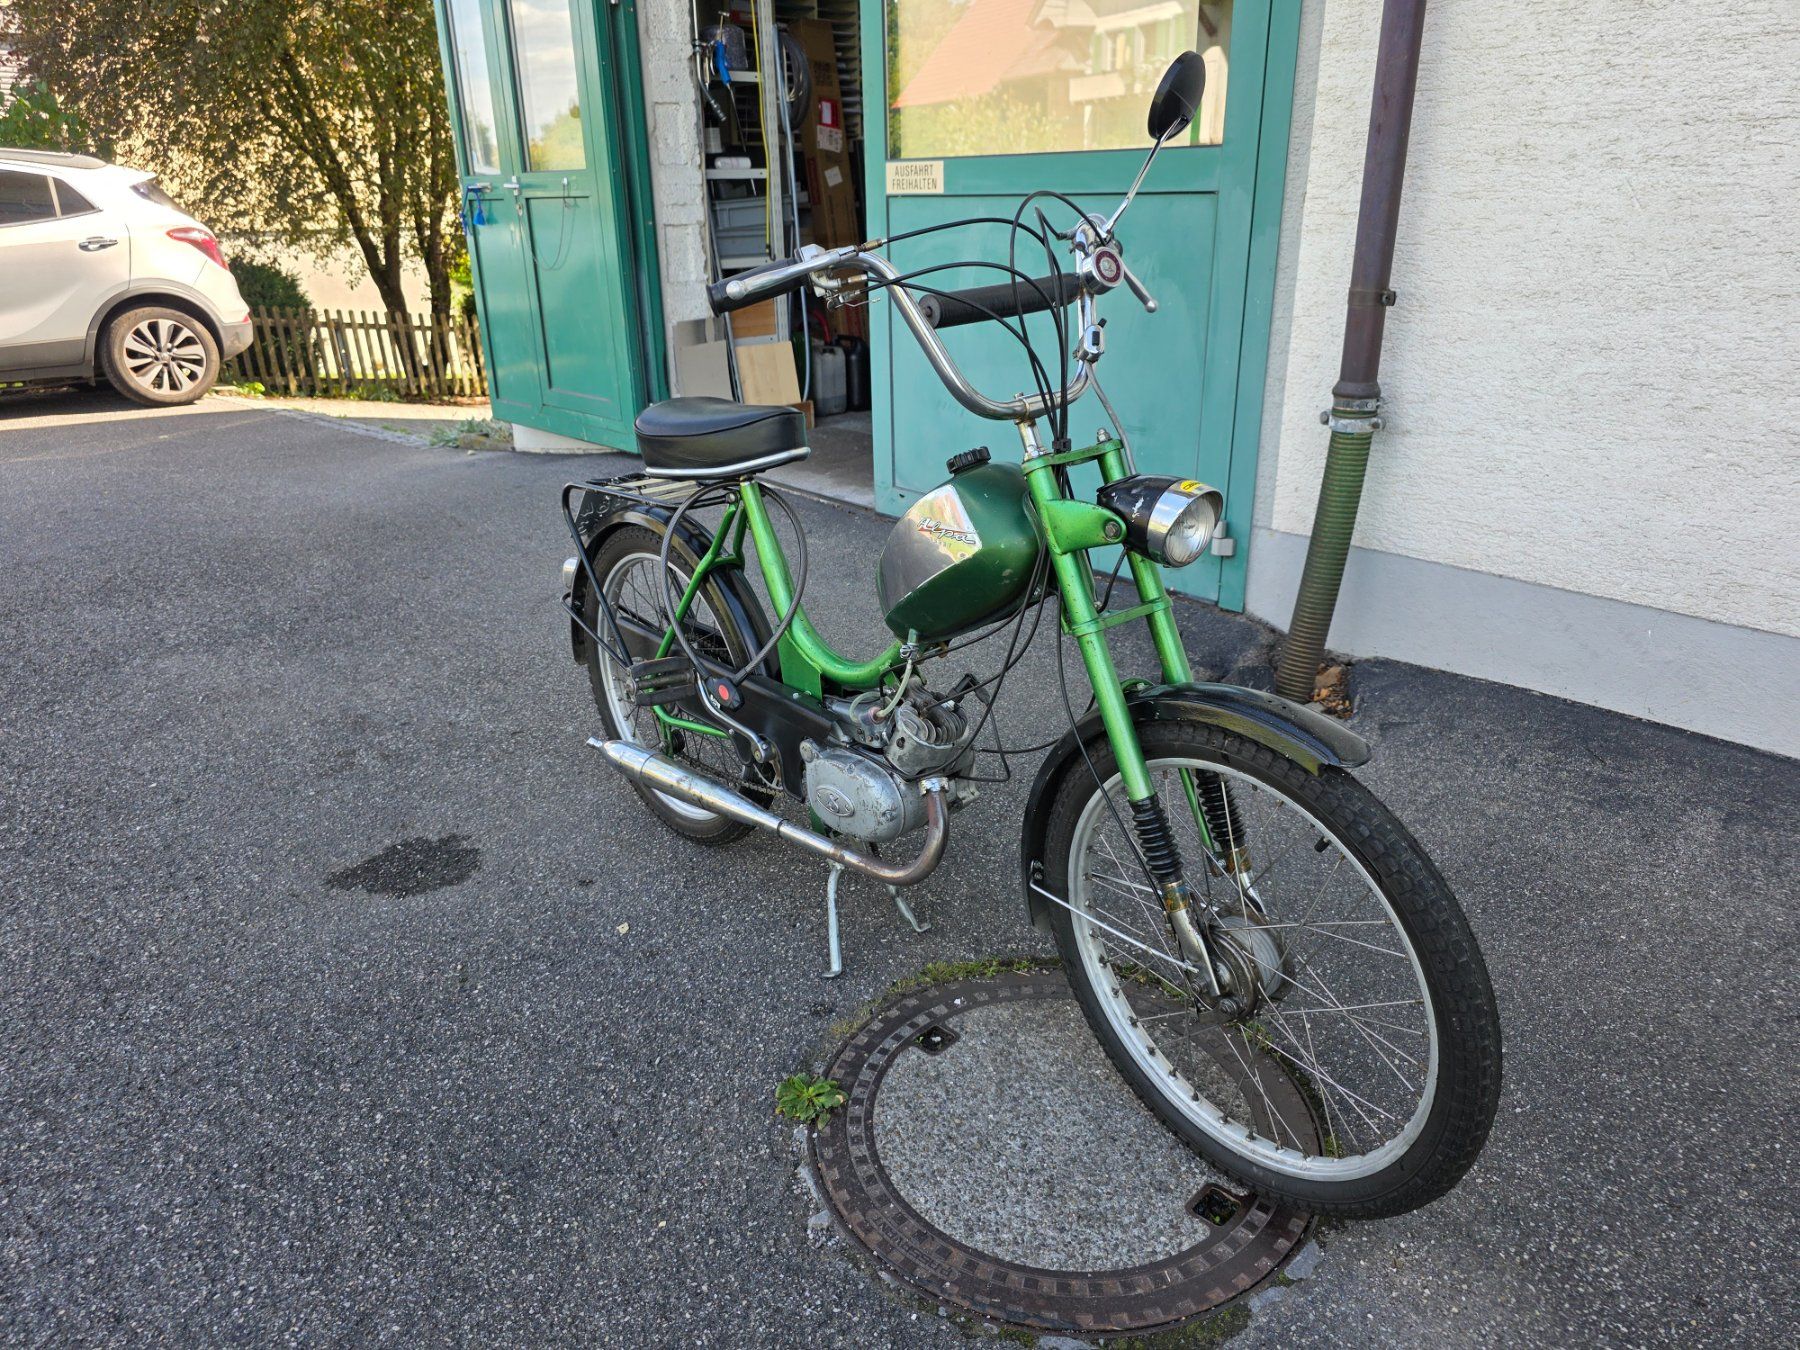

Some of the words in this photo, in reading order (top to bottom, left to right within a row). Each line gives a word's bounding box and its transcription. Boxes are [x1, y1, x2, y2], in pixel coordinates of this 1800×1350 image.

[895, 164, 934, 177] AUSFAHRT
[892, 178, 937, 190] FREIHALTEN
[917, 518, 976, 545] Alpa
